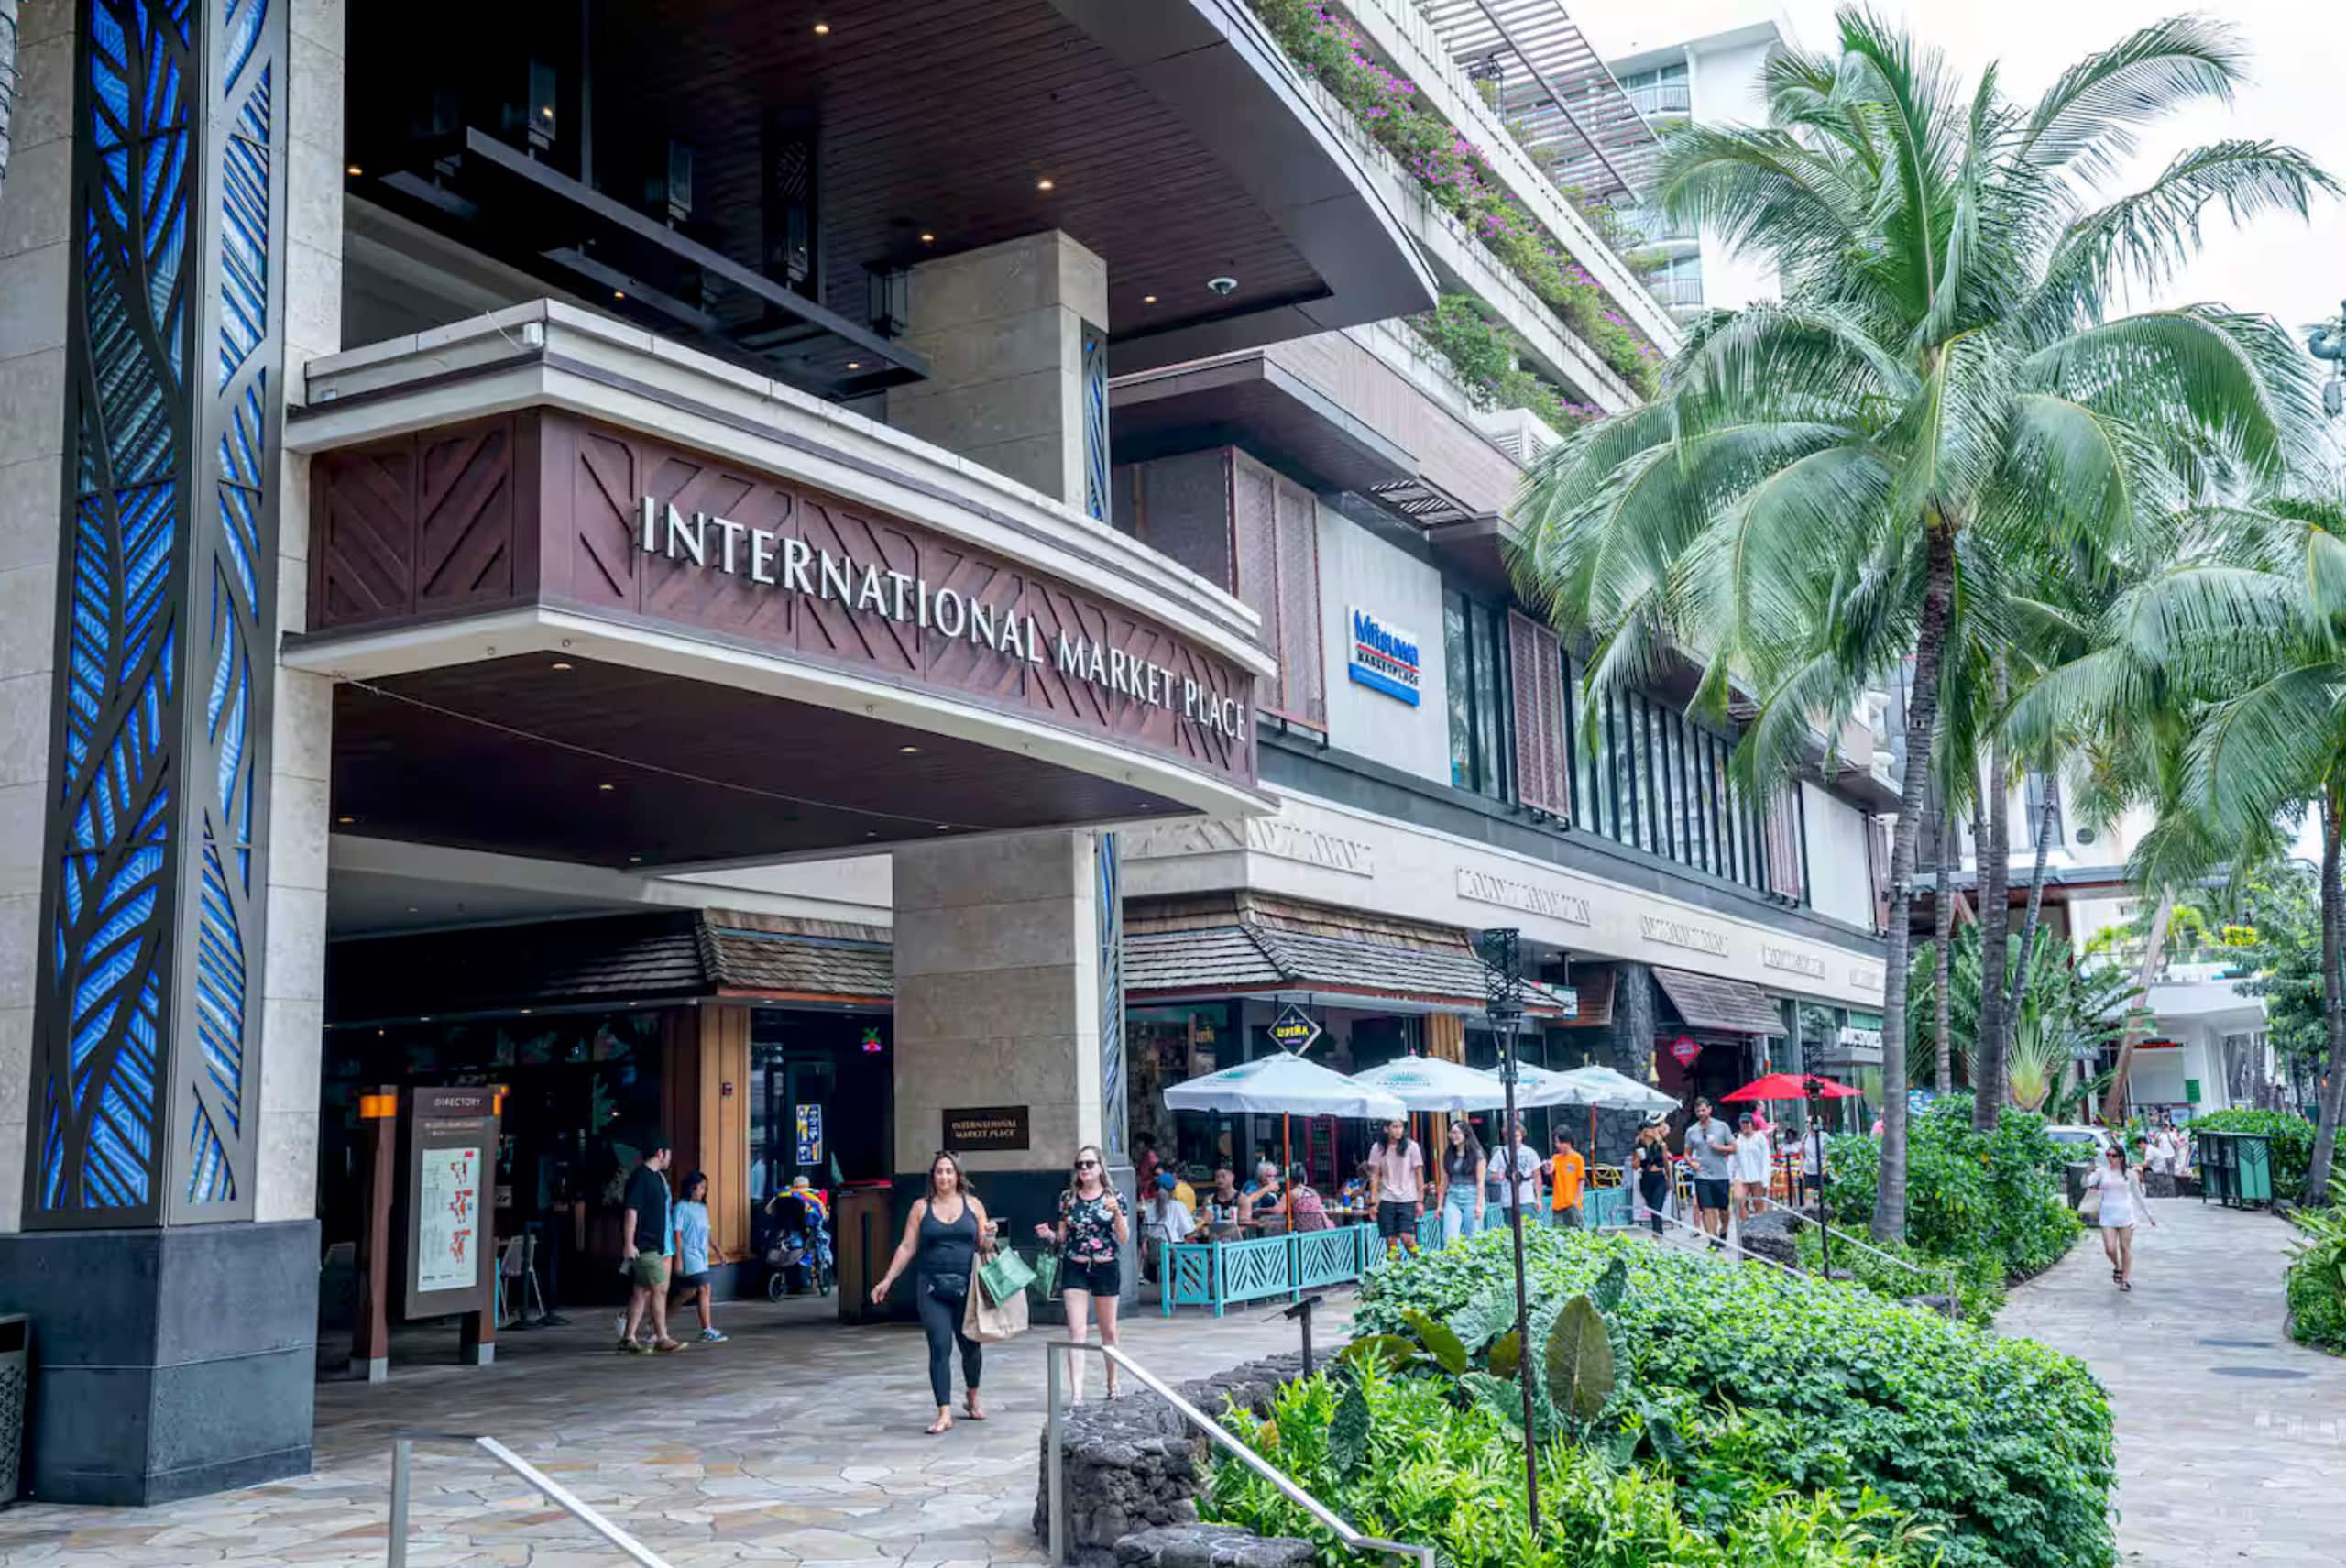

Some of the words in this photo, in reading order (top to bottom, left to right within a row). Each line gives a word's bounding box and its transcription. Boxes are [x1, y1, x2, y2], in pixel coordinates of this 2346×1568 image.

[641, 496, 1044, 664] INTERNATIONAL
[1059, 629, 1174, 709] MARKET
[1183, 676, 1246, 741] PLACE
[433, 1097, 482, 1108] DIRECTORY
[951, 1119, 1017, 1130] INTERNATIONAL
